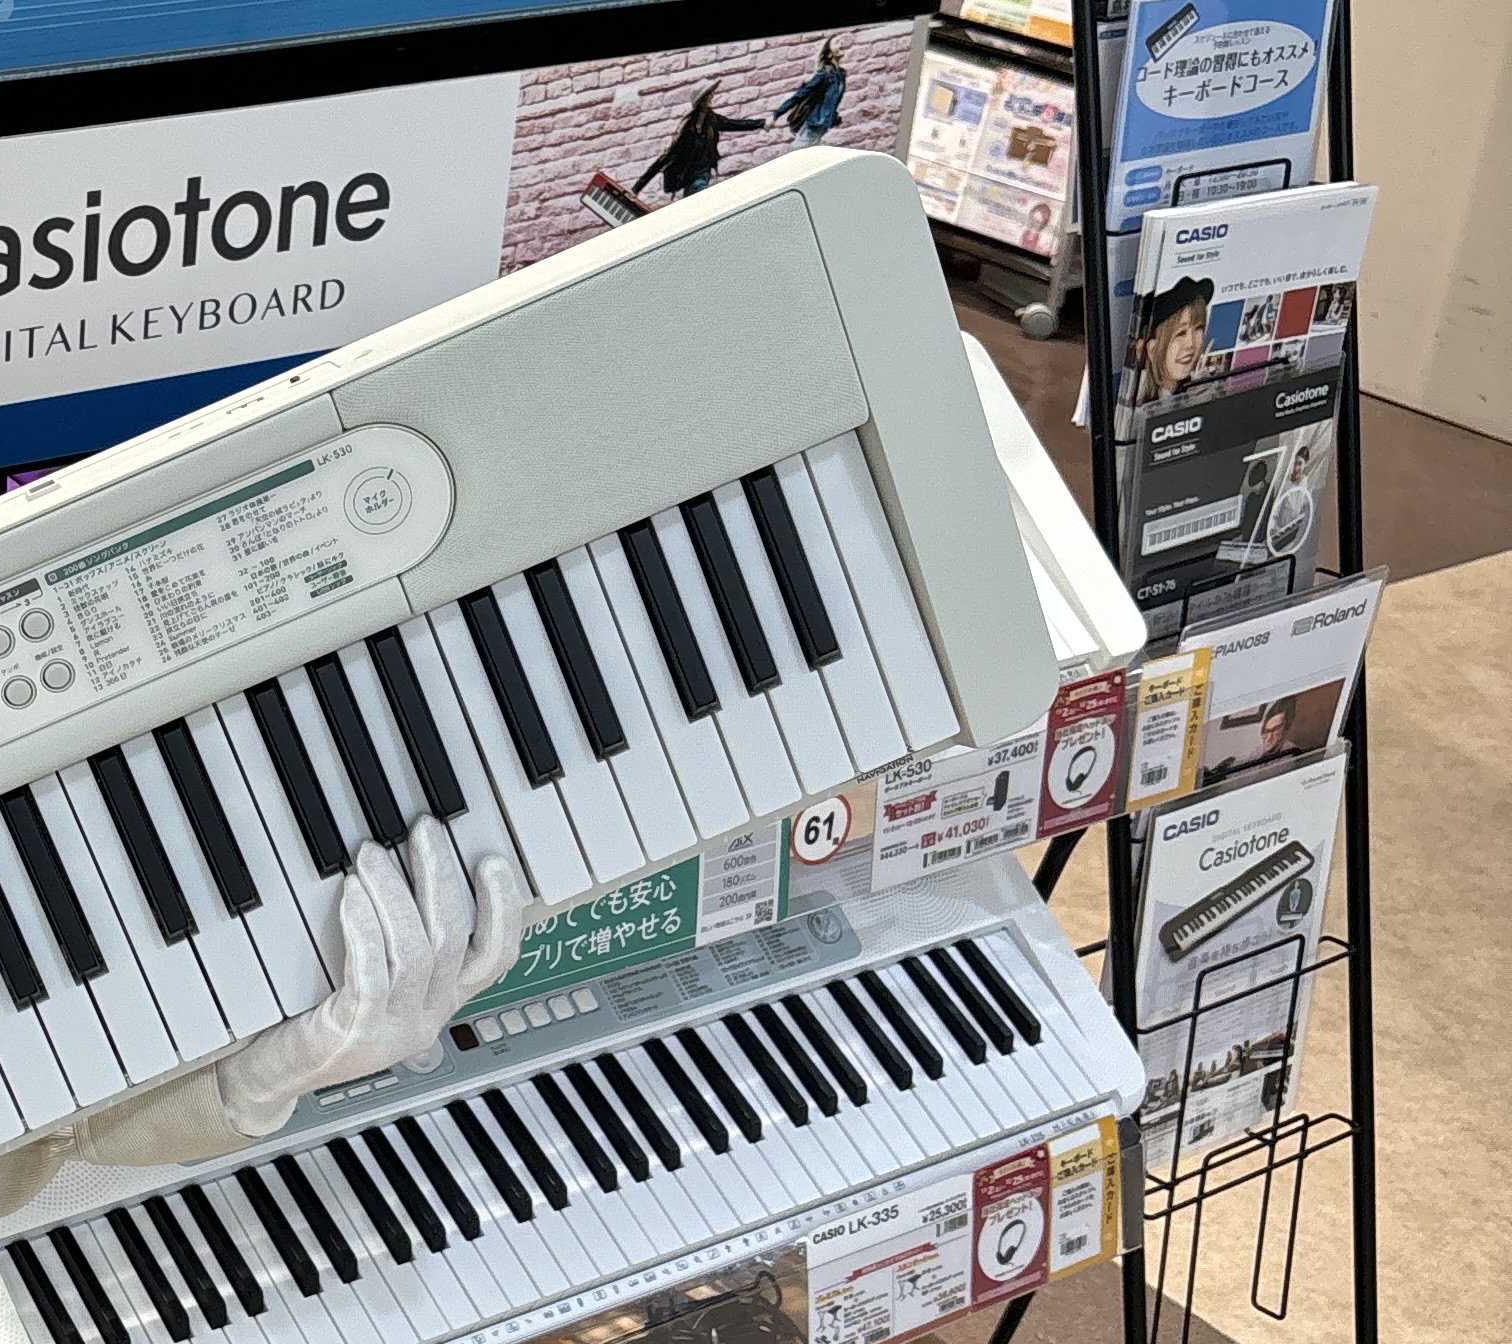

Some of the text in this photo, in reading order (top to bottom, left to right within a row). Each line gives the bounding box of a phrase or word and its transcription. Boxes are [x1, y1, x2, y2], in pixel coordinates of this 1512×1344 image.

[1137, 39, 1319, 83] コード理論の習得にもオススメ!
[1162, 68, 1290, 107] キーボードコース
[1175, 223, 1229, 245] CASIO
[108, 276, 347, 343] KEYBOARD
[1275, 384, 1330, 409] Casiotone
[1151, 416, 1203, 443] CASIO
[316, 444, 353, 467] LK-530
[363, 490, 387, 505] マイク
[364, 497, 395, 514] ホルダー
[1311, 599, 1368, 631] Roland
[1060, 726, 1106, 751] プレゼント!
[884, 740, 1036, 785] LK-530 ¥37,400
[937, 819, 988, 843] ¥41,030
[1162, 809, 1221, 842] CASIO
[1199, 826, 1290, 872] Casiotone
[518, 907, 682, 978] プリで増やせる
[812, 1225, 846, 1245] CASIO
[848, 1204, 900, 1236] LK-335
